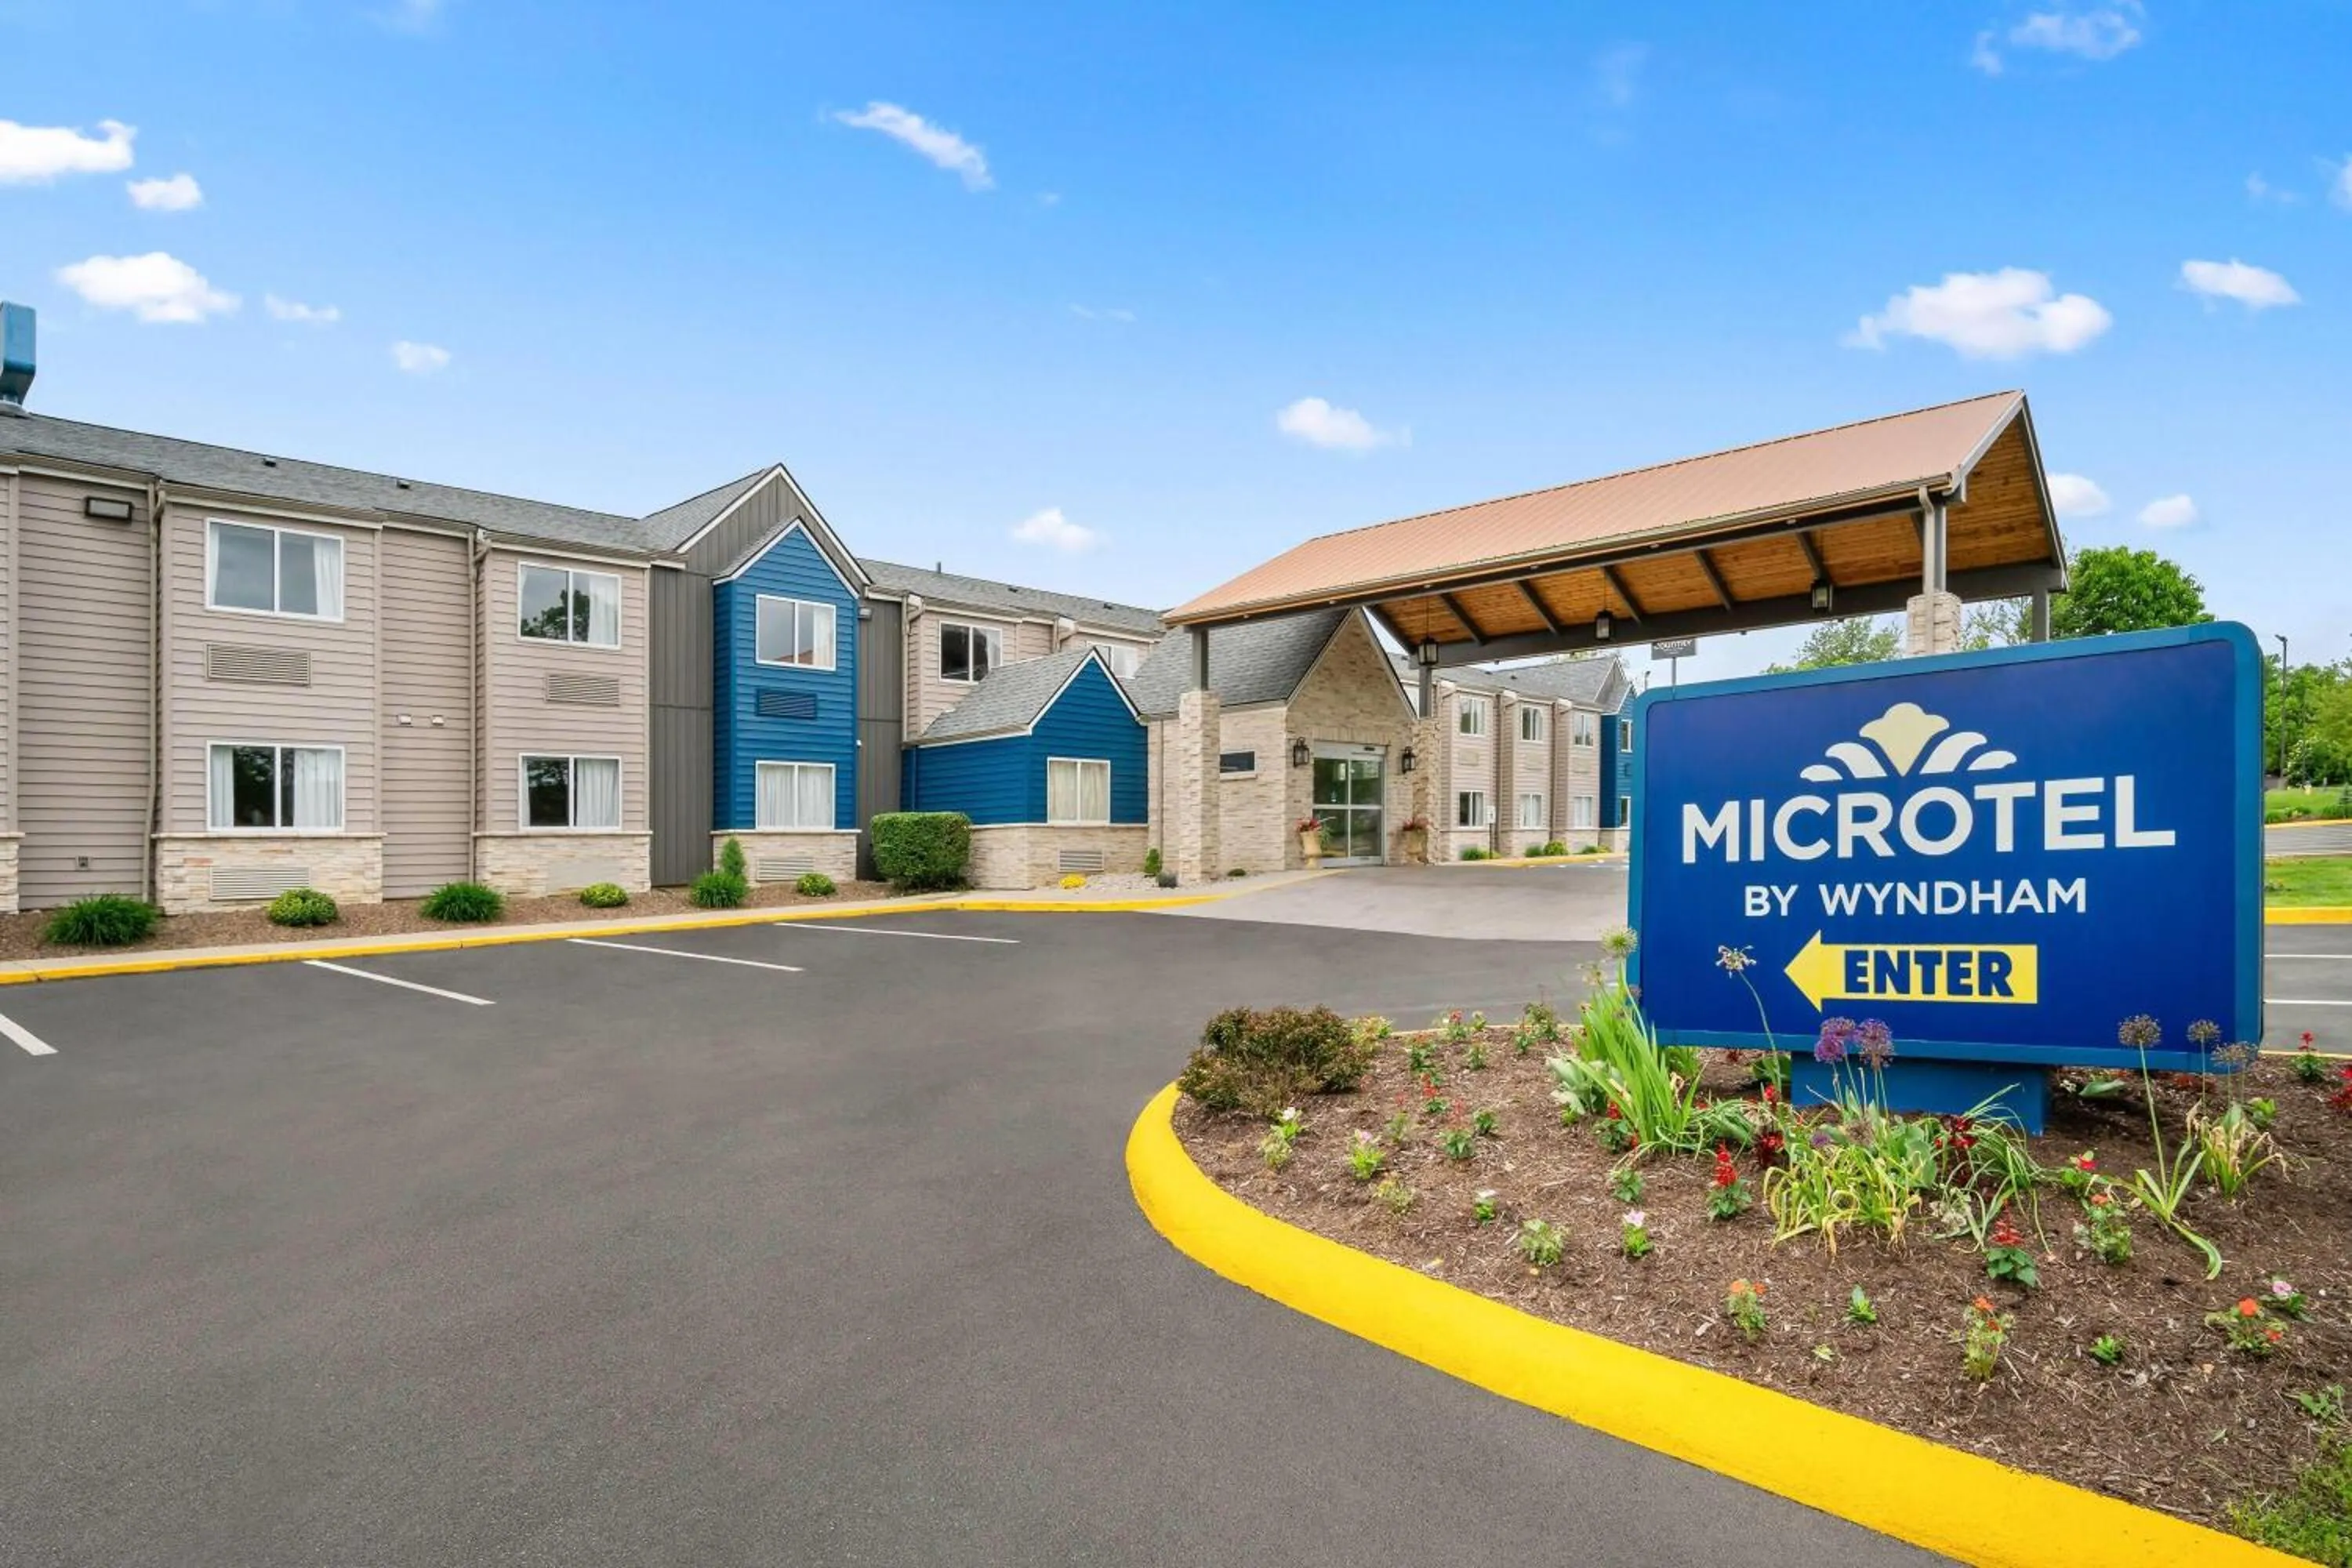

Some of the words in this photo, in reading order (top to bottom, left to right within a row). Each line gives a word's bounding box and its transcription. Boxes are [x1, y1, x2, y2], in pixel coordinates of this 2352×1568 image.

[1683, 775, 2176, 863] MICROTEL
[1745, 886, 1798, 916] BY
[1820, 877, 2085, 915] WYNDHAM
[1845, 949, 2014, 996] ENTER
